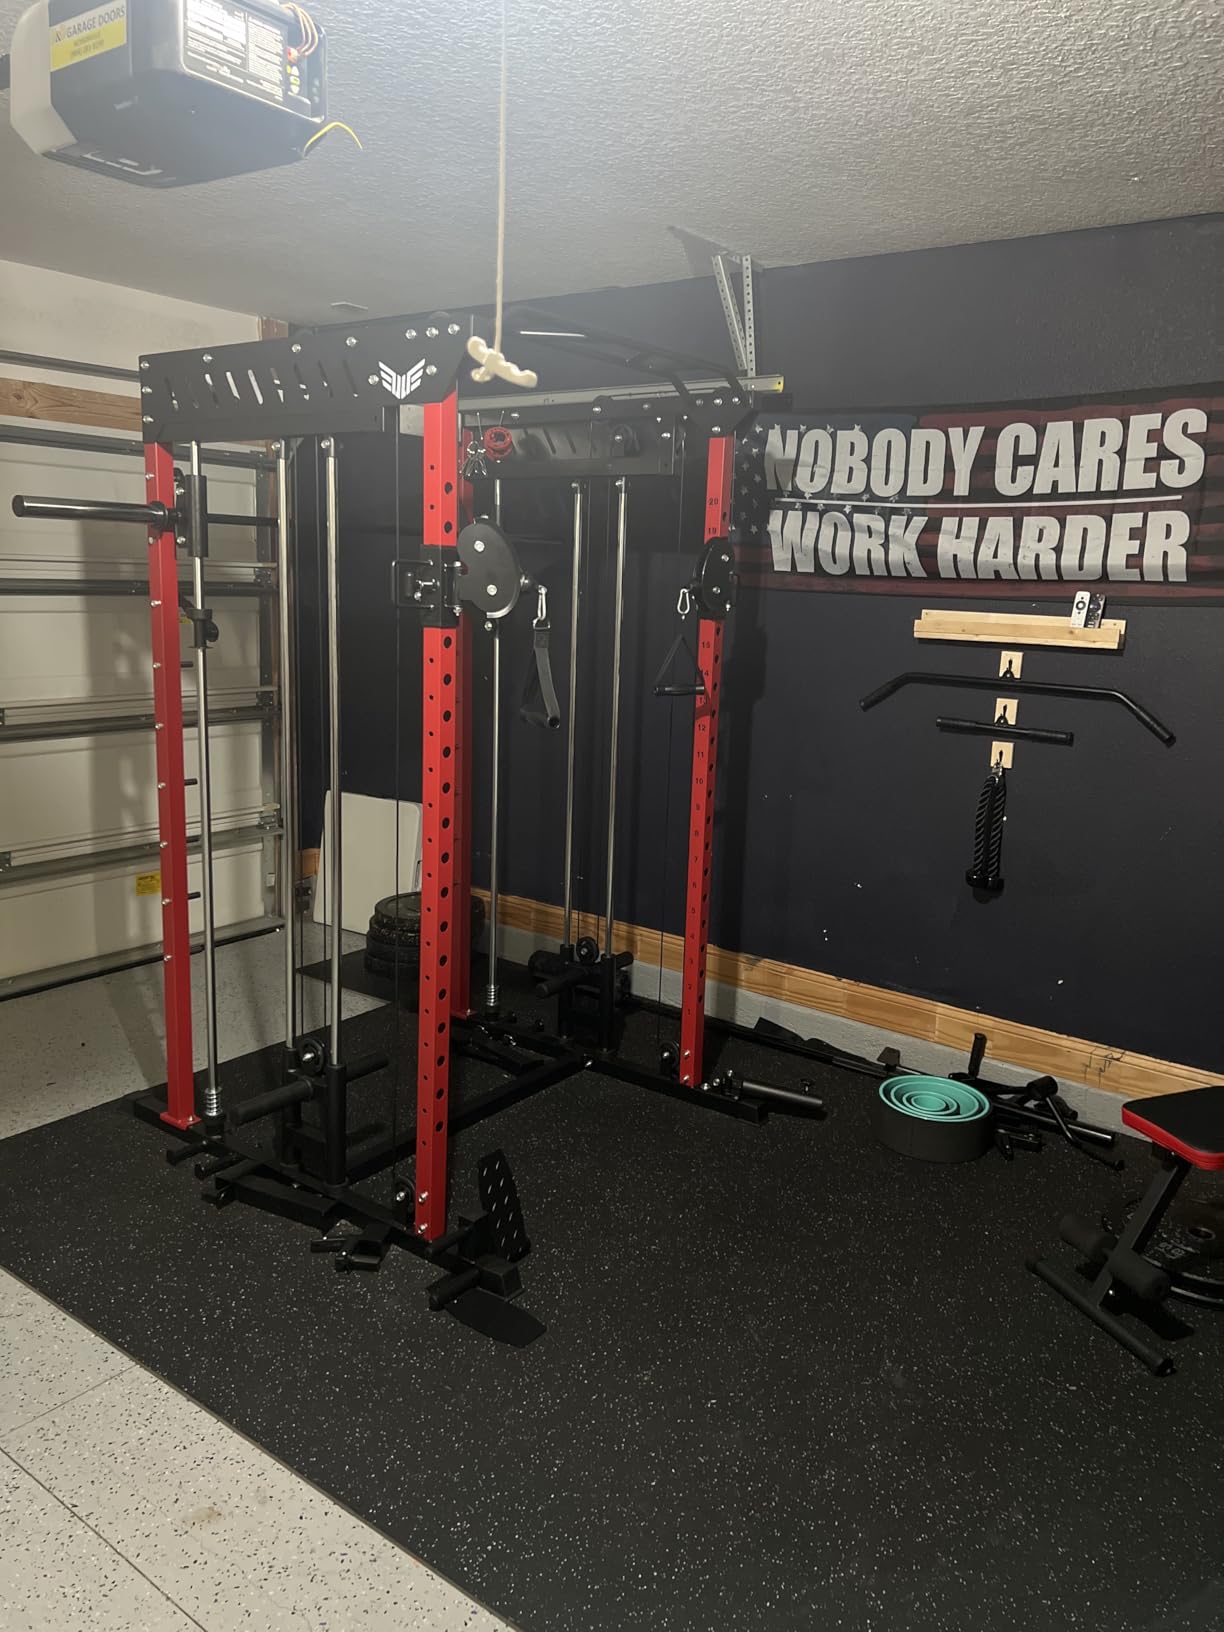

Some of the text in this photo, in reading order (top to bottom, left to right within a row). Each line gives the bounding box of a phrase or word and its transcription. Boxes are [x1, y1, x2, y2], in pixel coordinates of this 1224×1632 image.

[66, 16, 97, 38] GARAGE
[98, 5, 126, 27] DOORS
[764, 408, 1208, 497] NOBODY CARES
[708, 497, 719, 505] 20
[767, 509, 1190, 582] WORK HARDER
[698, 723, 706, 732] 12
[697, 751, 704, 759] 11
[695, 777, 704, 785] 10
